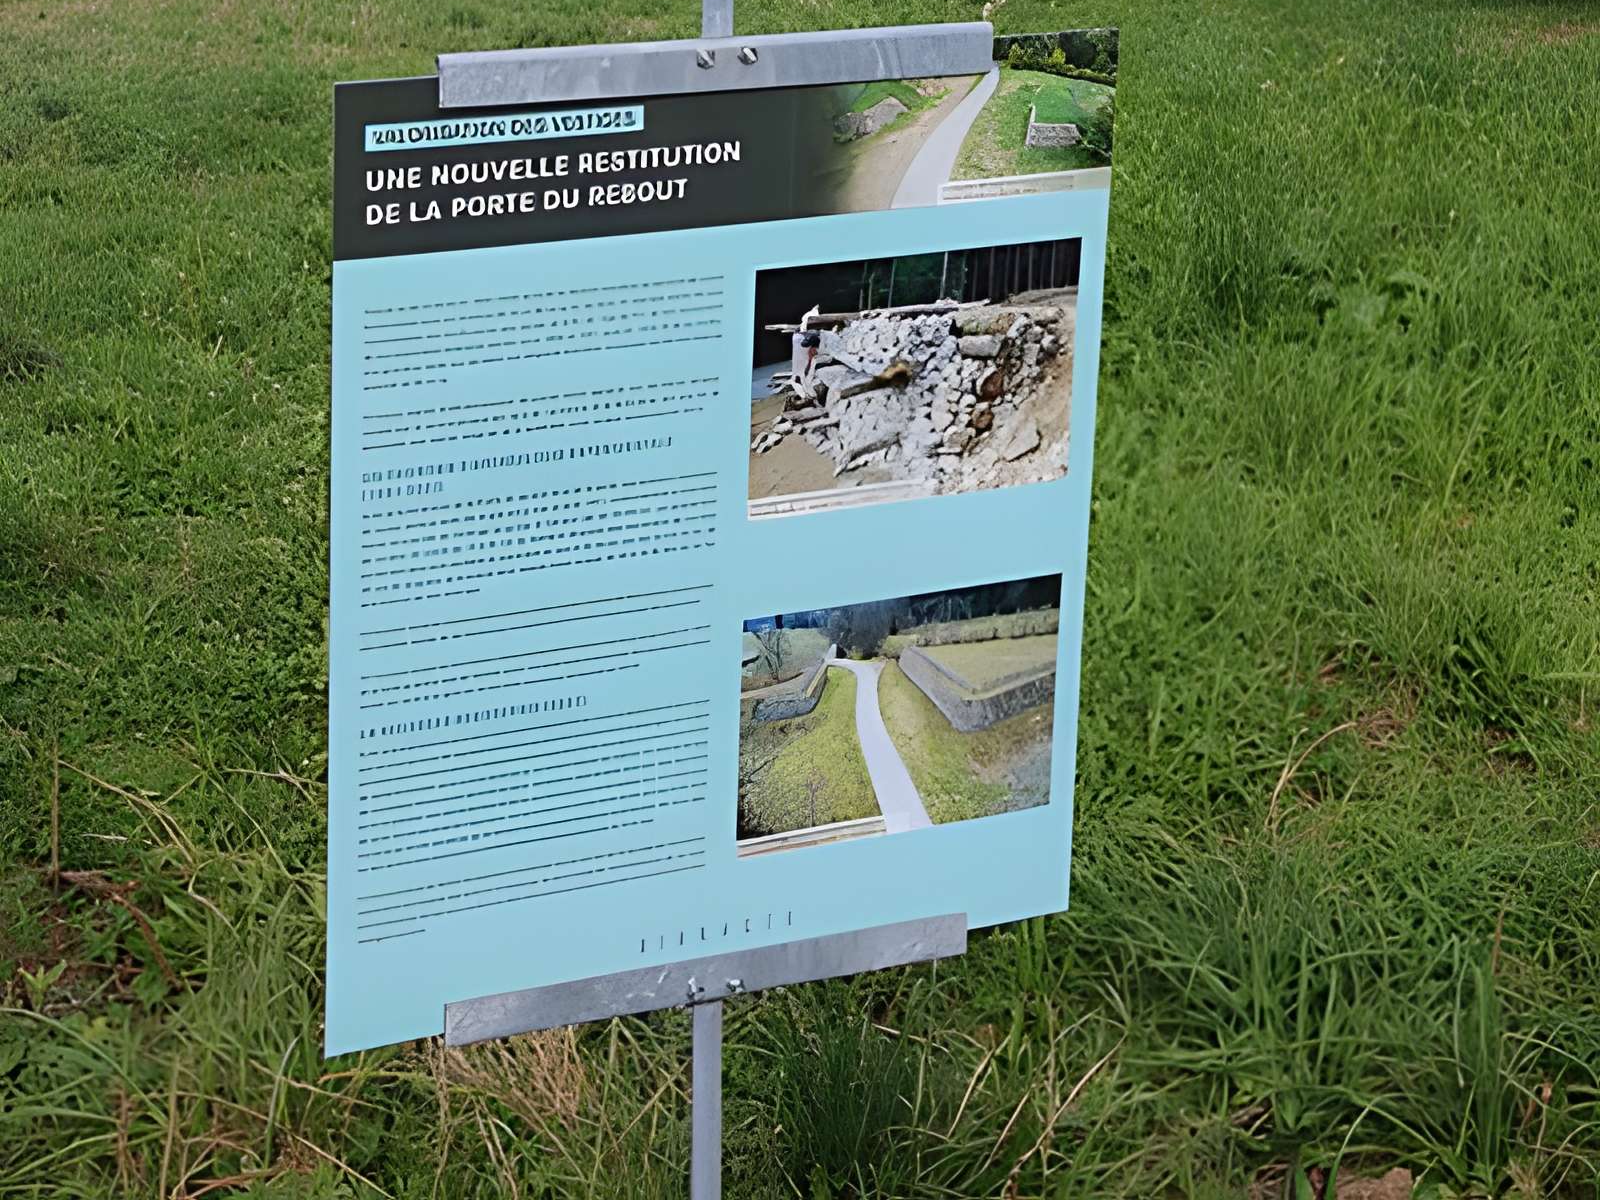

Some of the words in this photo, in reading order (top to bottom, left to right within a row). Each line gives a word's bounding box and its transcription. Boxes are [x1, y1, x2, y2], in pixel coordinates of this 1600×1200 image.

[366, 166, 422, 192] UNE
[431, 155, 569, 187] NOUVELLE
[578, 140, 741, 174] RESTITUTION
[366, 203, 401, 226] DE
[409, 200, 442, 222] LA
[451, 191, 535, 218] PORTE
[543, 188, 580, 210] DU
[588, 178, 688, 207] REBOUT
